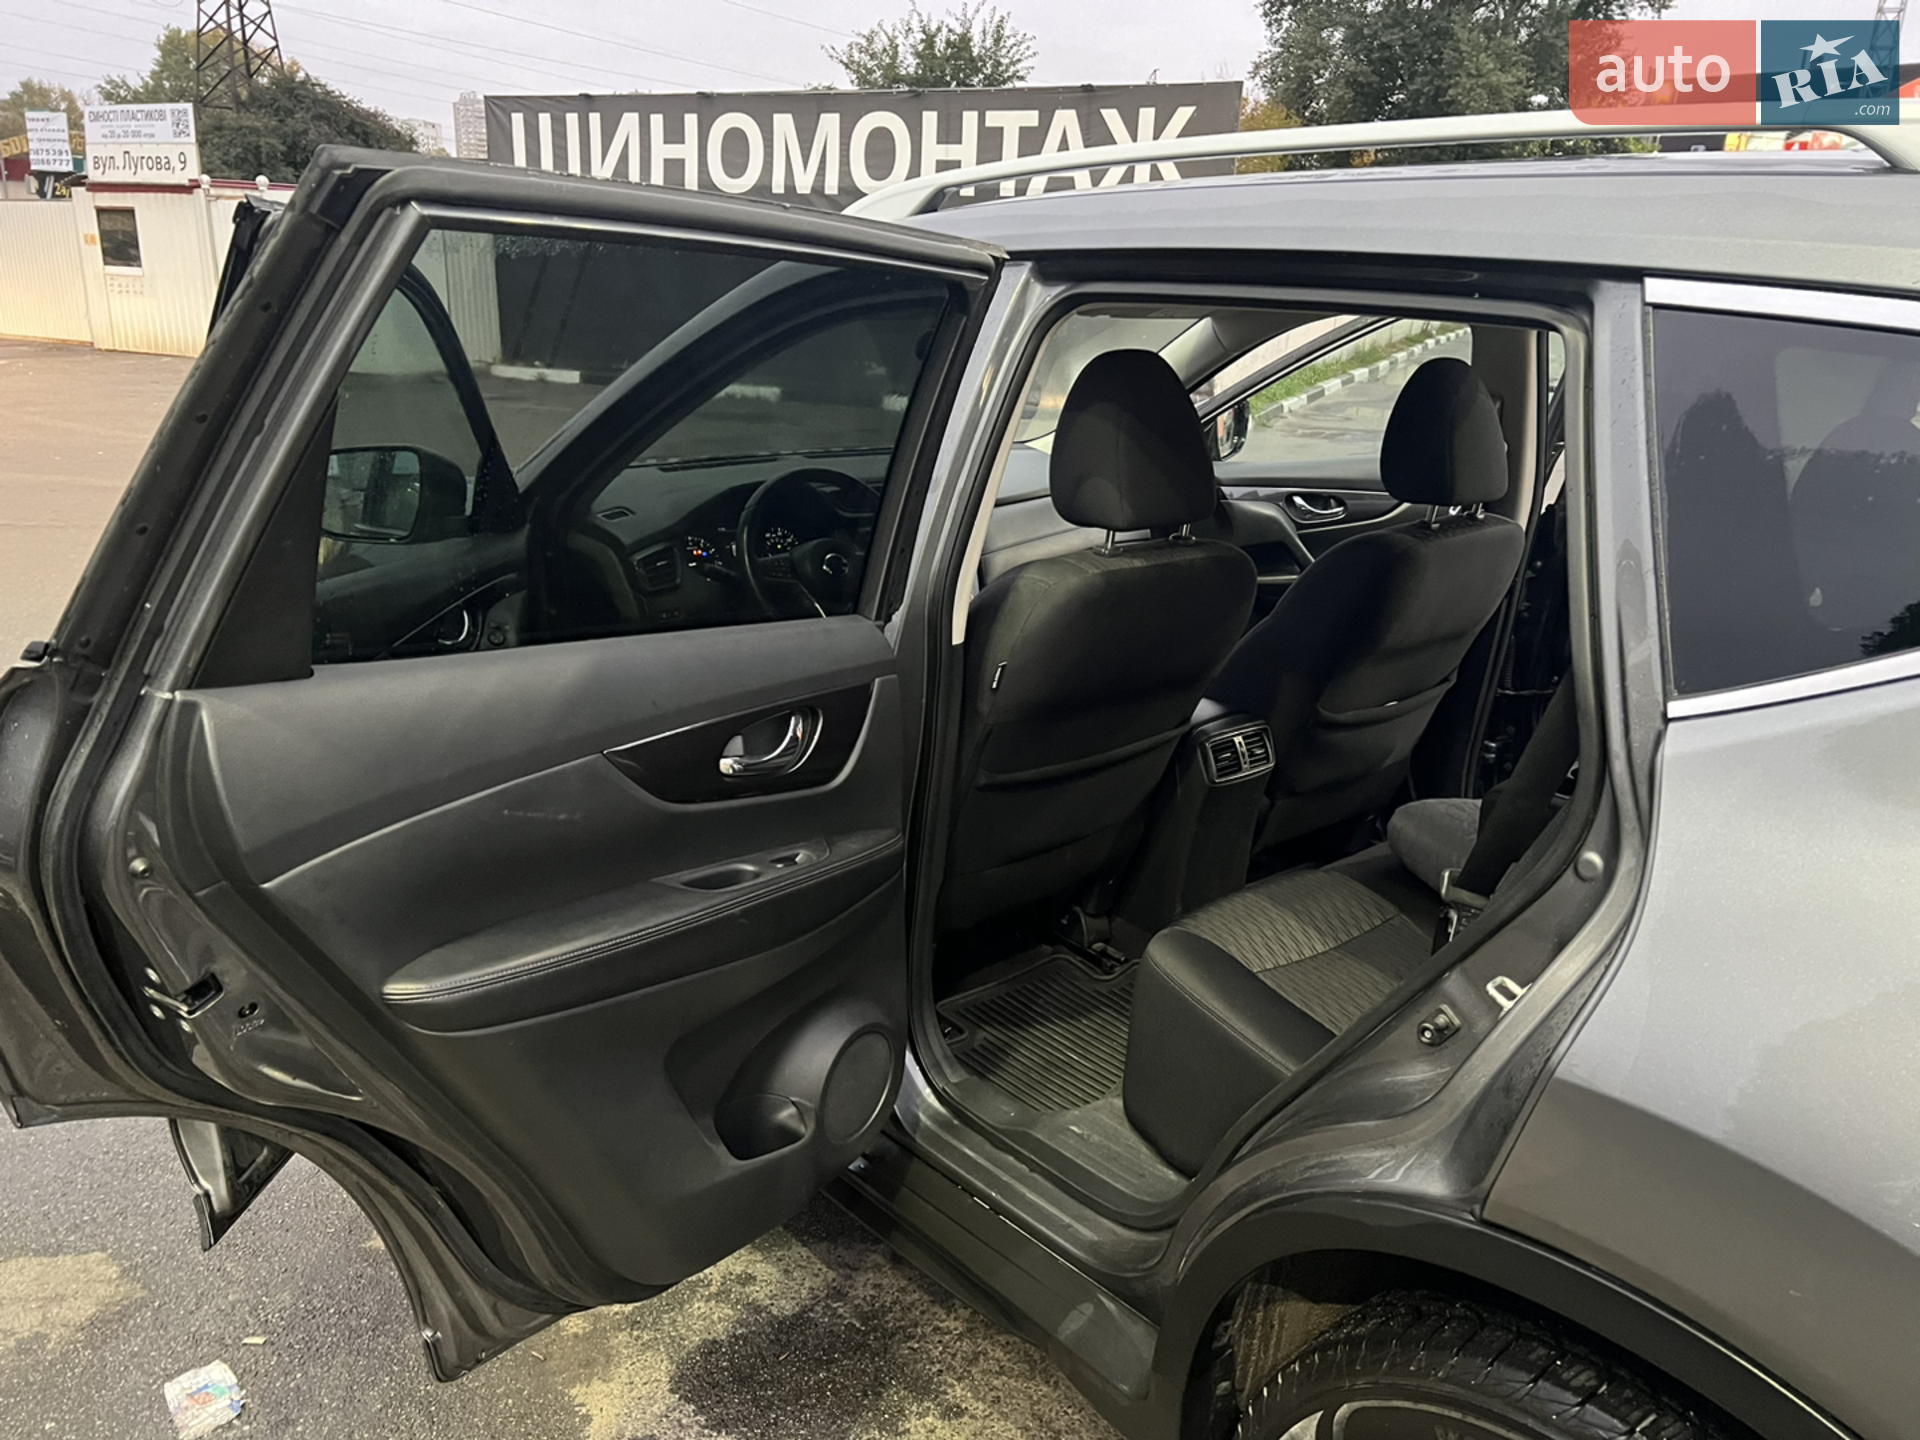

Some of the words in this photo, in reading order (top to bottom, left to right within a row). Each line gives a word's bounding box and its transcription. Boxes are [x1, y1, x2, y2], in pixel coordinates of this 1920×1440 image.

[120, 109, 167, 122] ПЛАСТИКОВІ
[93, 155, 120, 176] вул.
[122, 150, 175, 176] Лугова,
[178, 152, 187, 171] 9
[510, 106, 1197, 197] ШИНОМОНТАЖ
